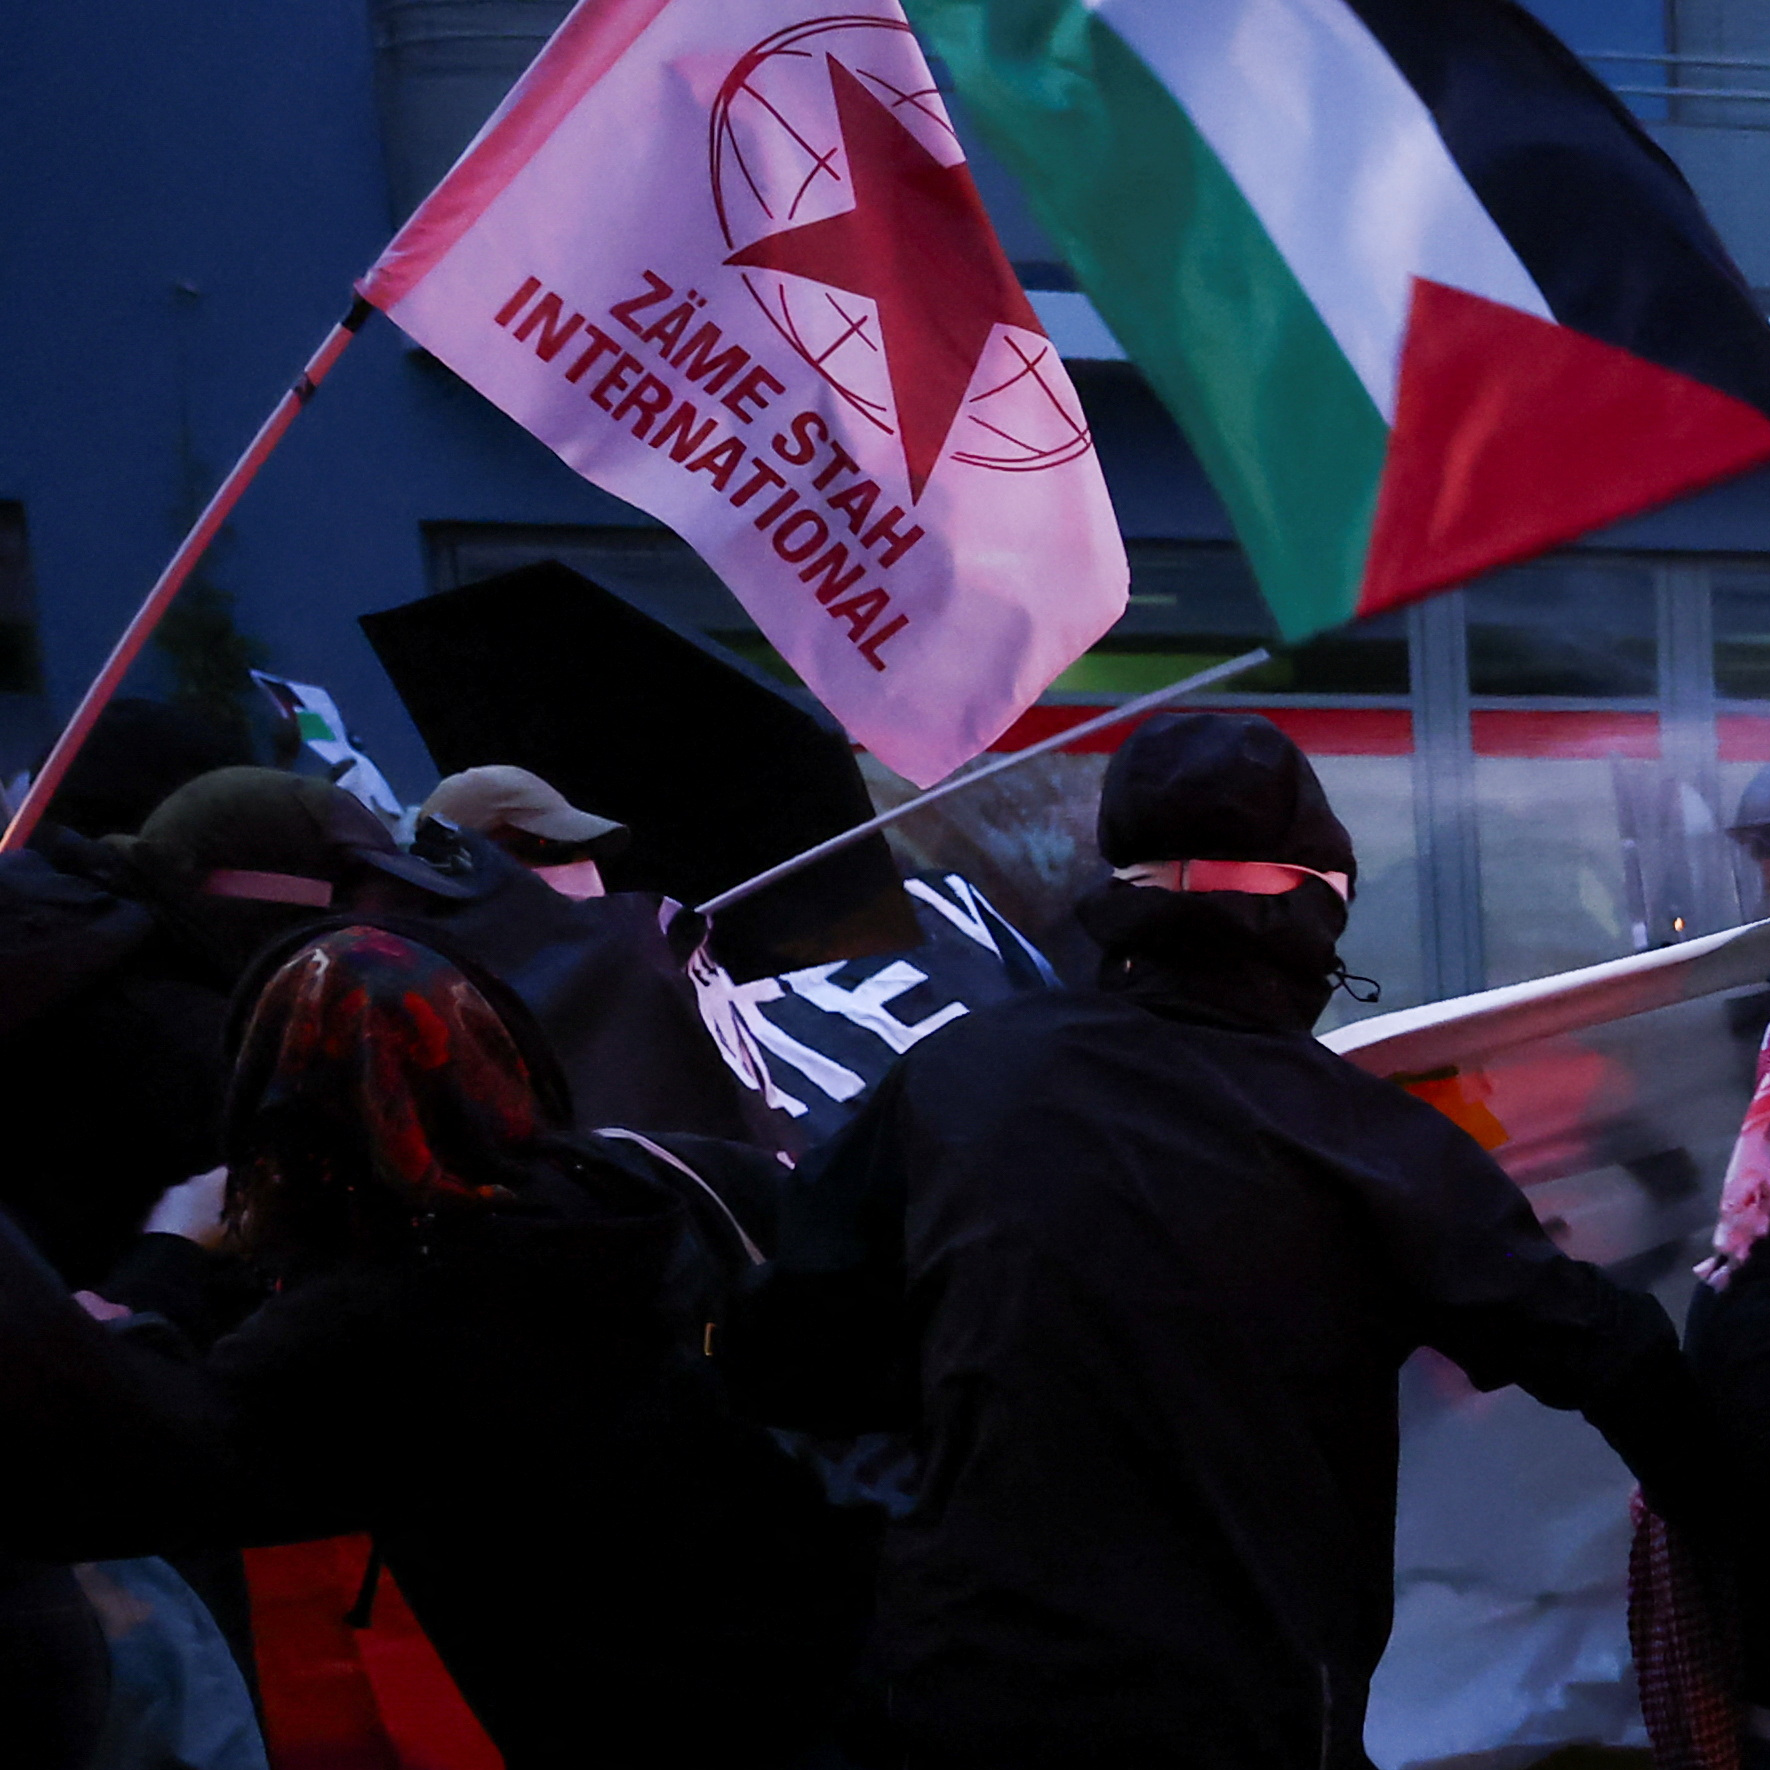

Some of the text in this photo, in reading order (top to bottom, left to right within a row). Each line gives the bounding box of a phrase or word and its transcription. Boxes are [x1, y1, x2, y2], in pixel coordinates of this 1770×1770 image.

[493, 275, 910, 673] INTERNATIONAL
[608, 268, 925, 571] ZÄME STAH
